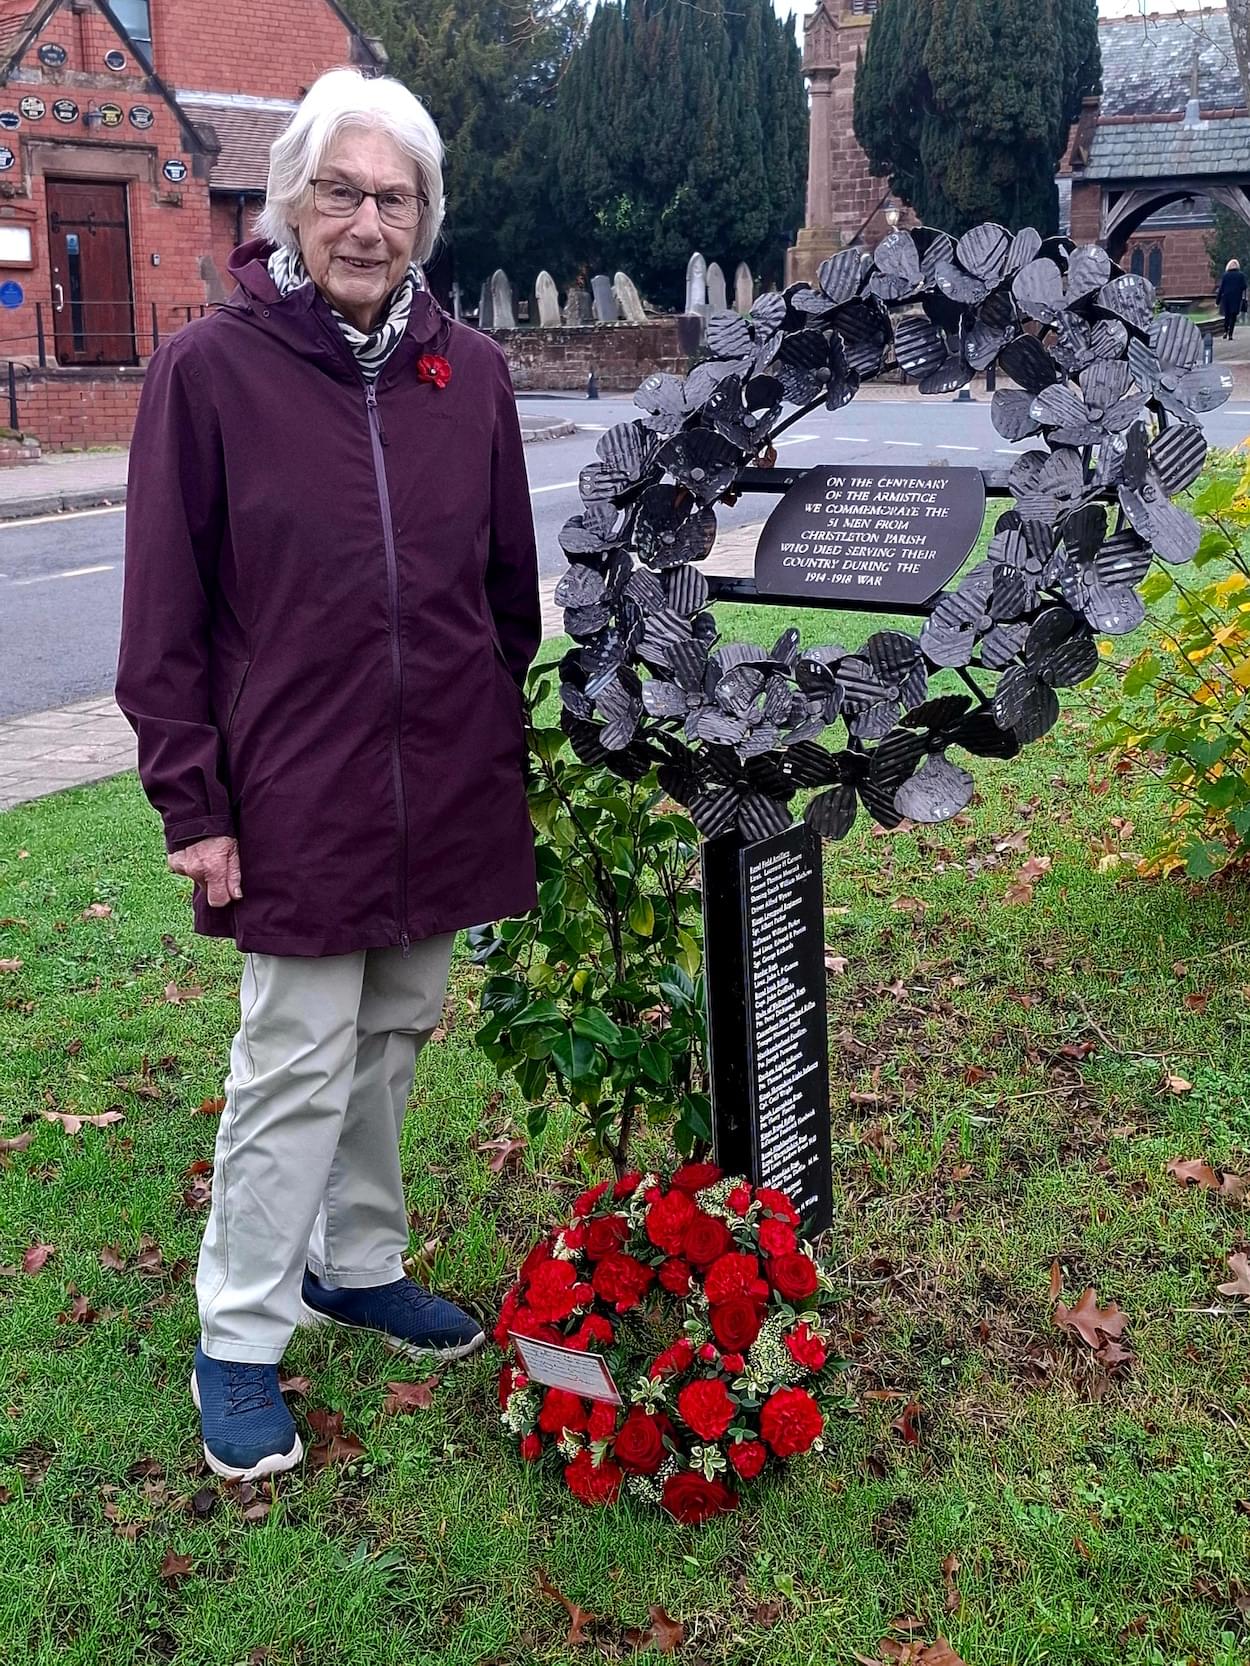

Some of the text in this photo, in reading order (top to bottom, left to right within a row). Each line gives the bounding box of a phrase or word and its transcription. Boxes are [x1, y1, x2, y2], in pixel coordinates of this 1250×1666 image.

[827, 477, 948, 490] ON THE CENTENARY
[825, 491, 937, 503] OF THE ARMISTICE
[805, 504, 949, 517] WE COMMEMORATE THE
[843, 519, 870, 529] MEN
[874, 520, 909, 530] FROM
[801, 530, 926, 545] CHRISTLETON PARISH
[780, 543, 936, 559] WHO DIED SERVING THEIR
[782, 557, 920, 574] COUNTRY DURING THE
[857, 575, 882, 586] WAR
